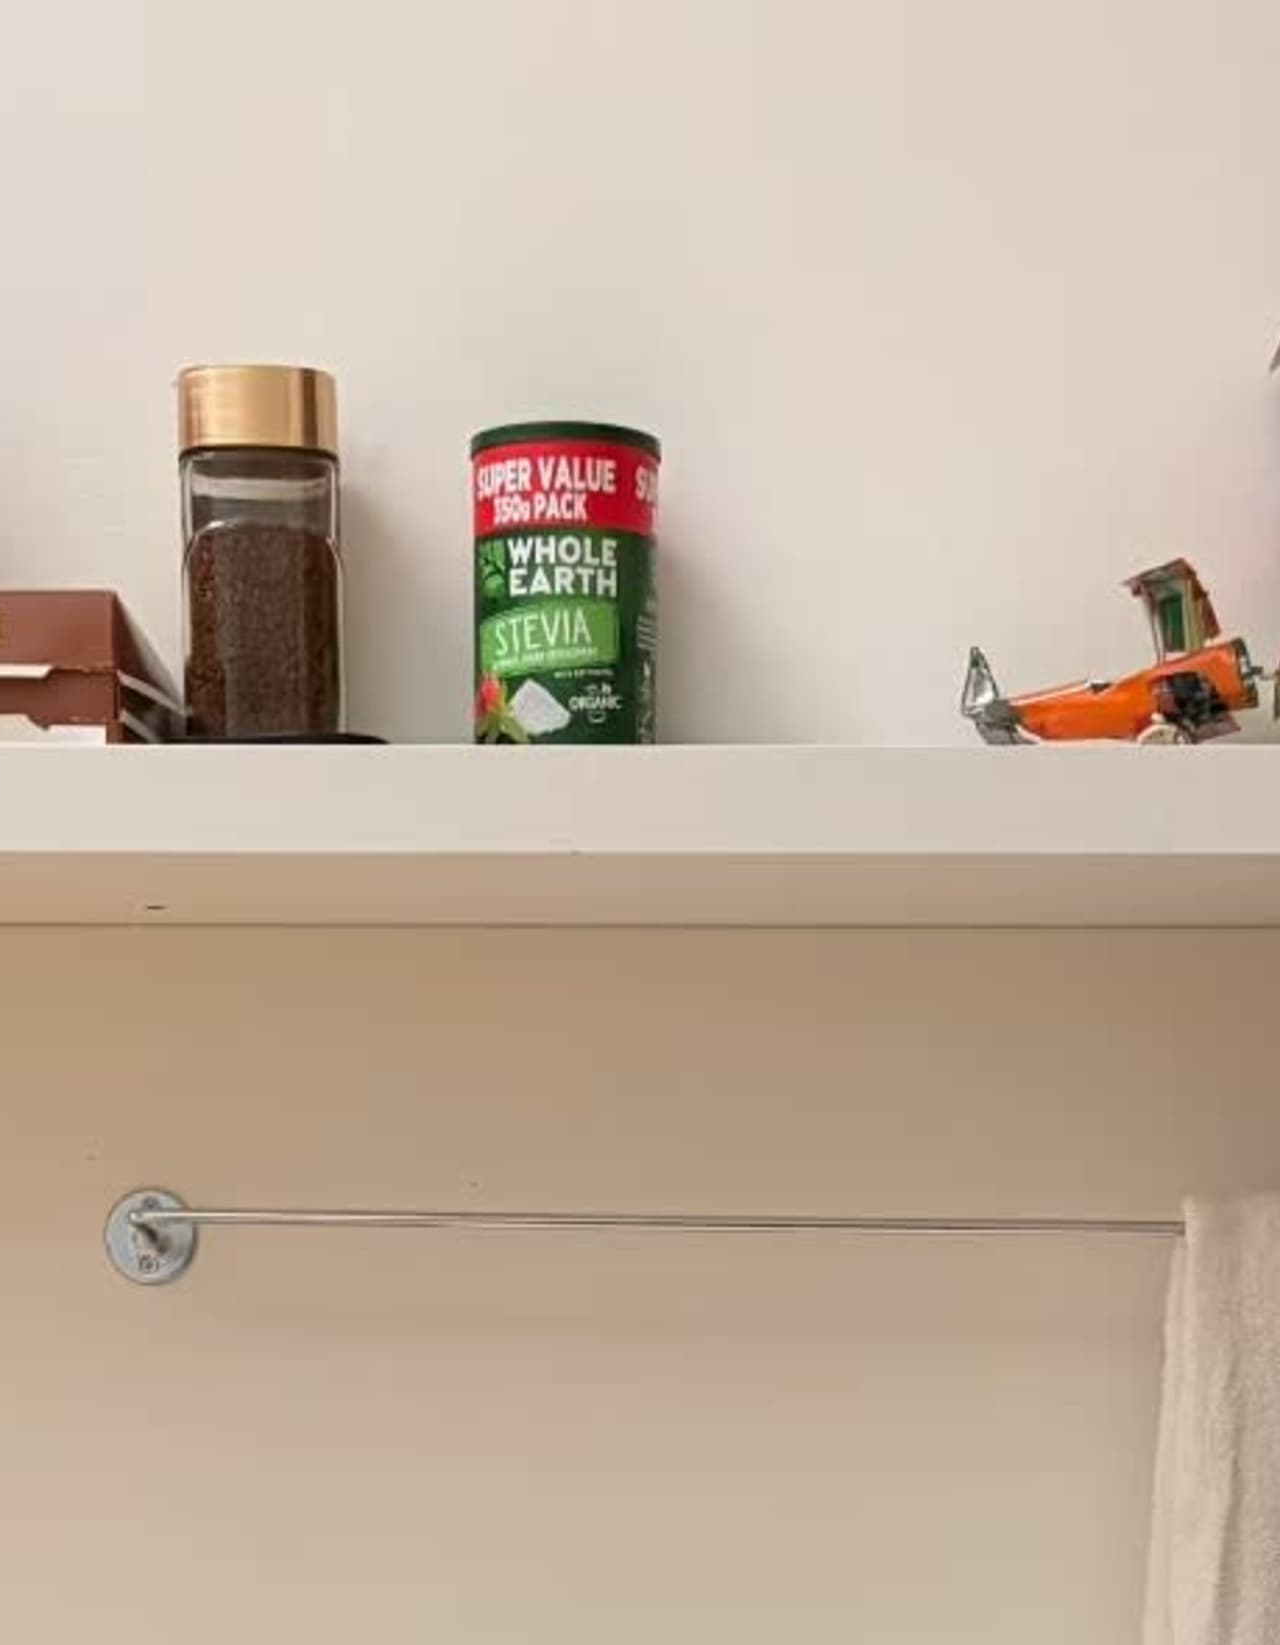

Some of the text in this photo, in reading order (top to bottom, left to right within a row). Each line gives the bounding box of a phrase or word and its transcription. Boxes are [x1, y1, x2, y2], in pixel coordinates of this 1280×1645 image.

[478, 457, 531, 499] SUPER
[538, 456, 616, 492] VALUE
[534, 491, 588, 521] PACK
[507, 536, 617, 566] WHOLE
[509, 566, 617, 598] EARTH
[495, 606, 592, 656] STEVIA
[569, 695, 622, 711] ORGANIC
